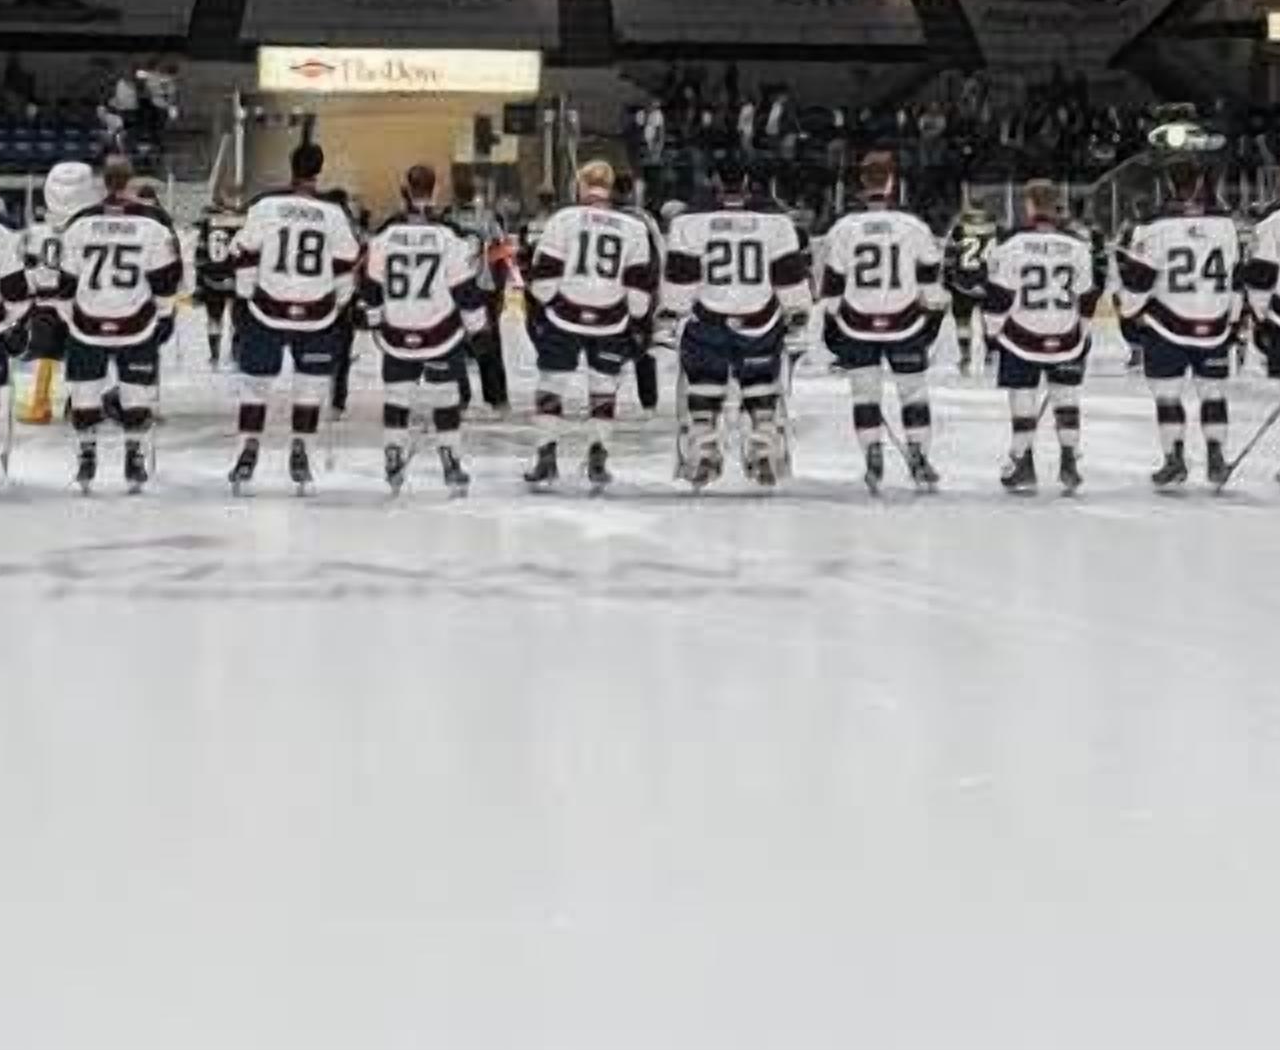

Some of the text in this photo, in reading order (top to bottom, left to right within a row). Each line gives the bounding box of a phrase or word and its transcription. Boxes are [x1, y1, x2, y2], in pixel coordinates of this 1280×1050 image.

[82, 243, 144, 290] 75
[273, 227, 324, 276] 18
[576, 230, 622, 278] 19
[707, 240, 763, 285] 20
[854, 243, 901, 288] 21
[1169, 246, 1227, 294] 24
[385, 253, 440, 299] 67
[1021, 265, 1073, 310] 23
